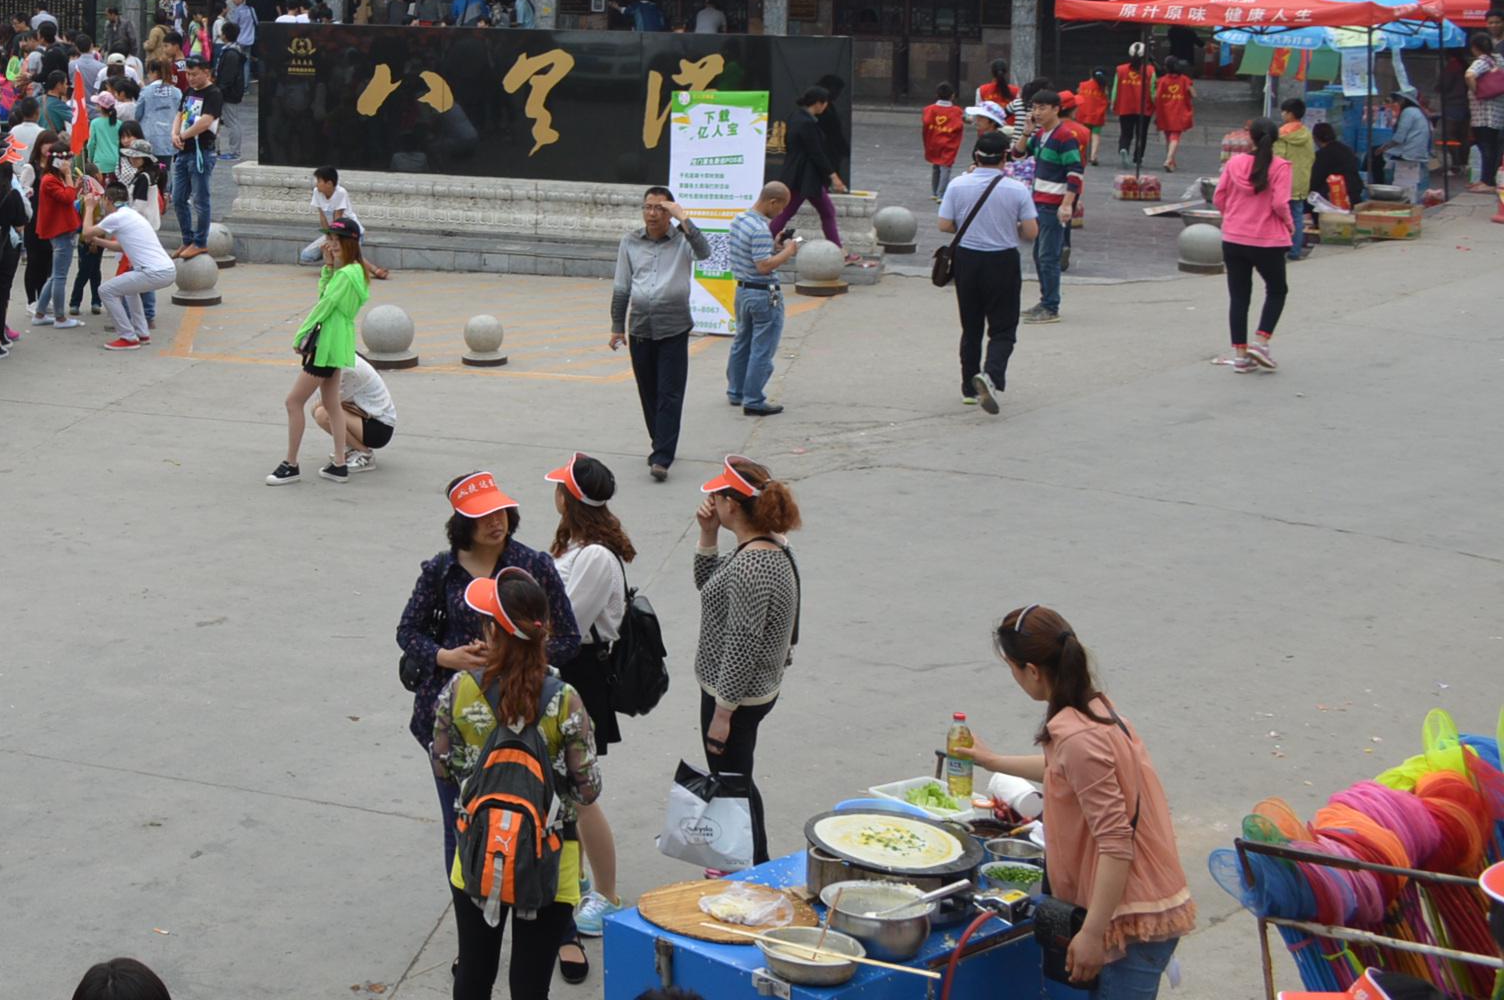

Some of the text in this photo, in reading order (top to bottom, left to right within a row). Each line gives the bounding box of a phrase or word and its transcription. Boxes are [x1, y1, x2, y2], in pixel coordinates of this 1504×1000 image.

[1118, 3, 1313, 23] 原汁原味 健康人生
